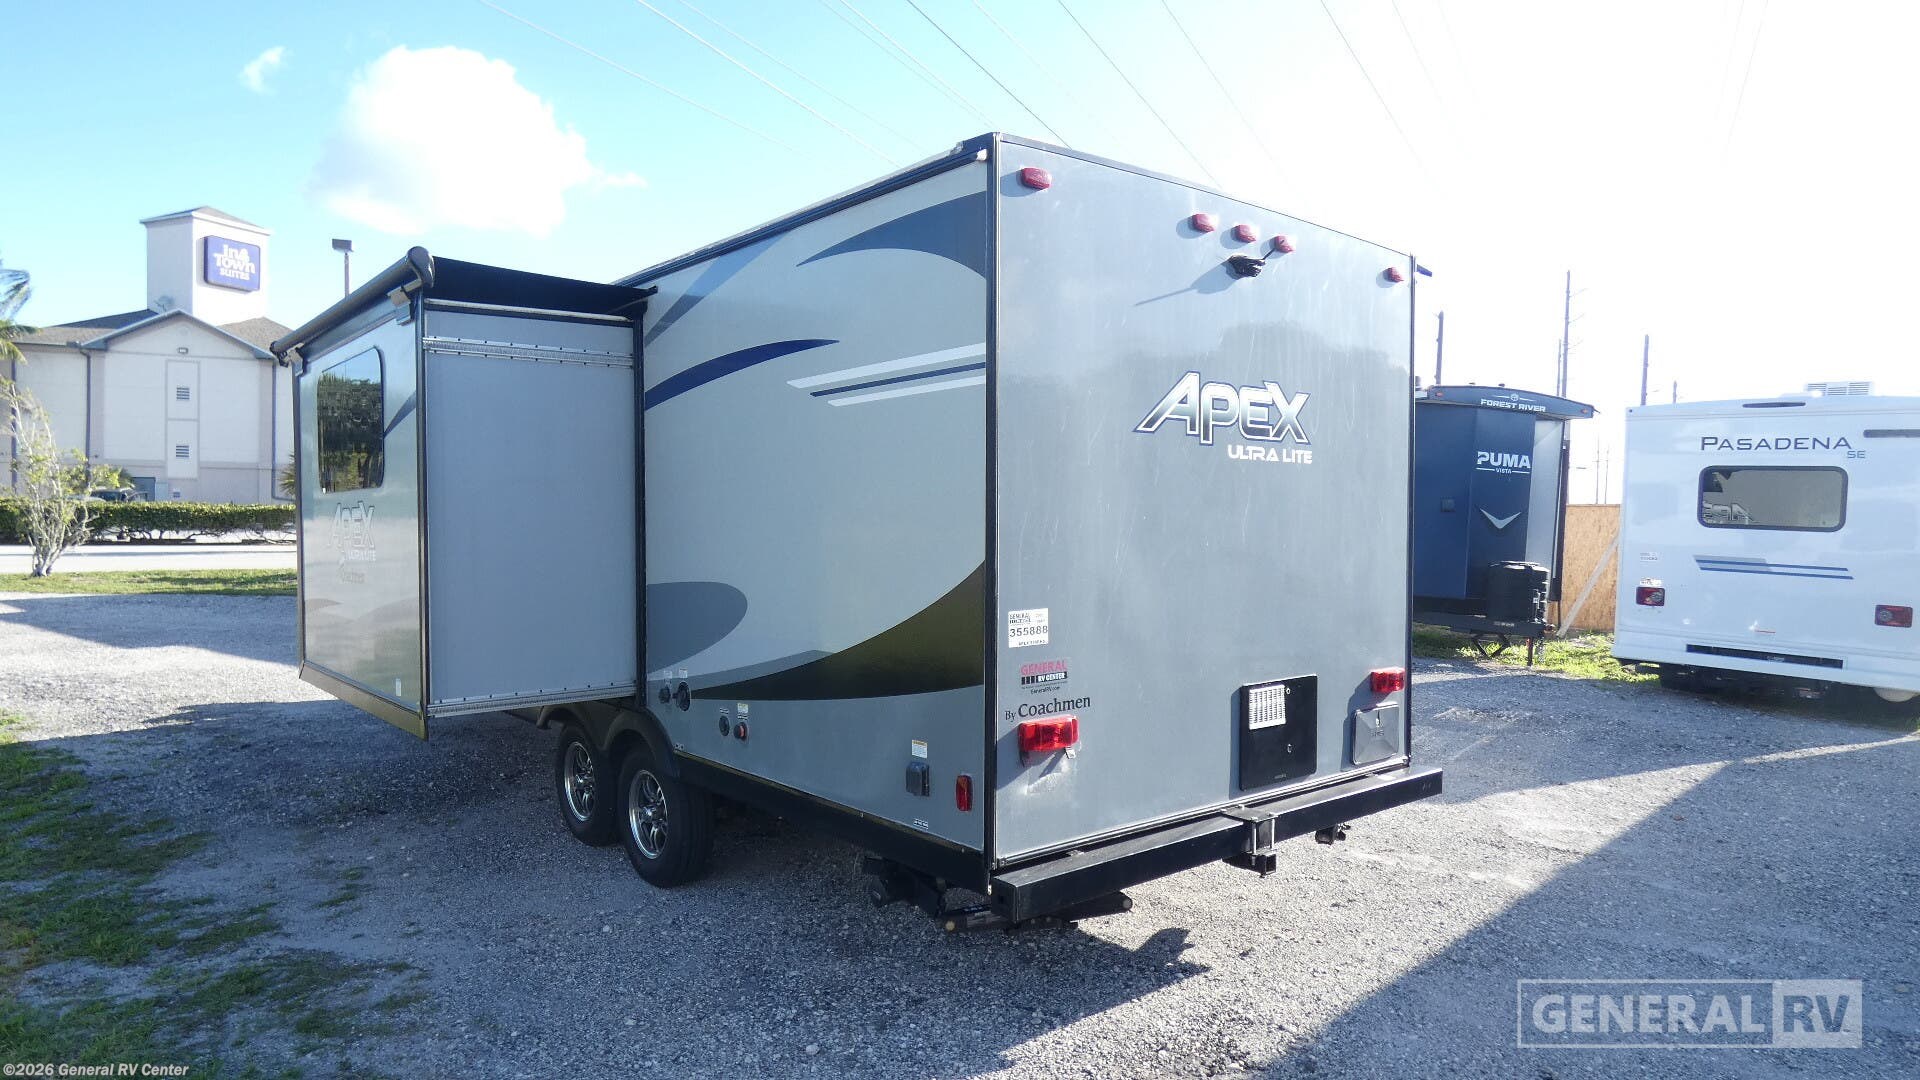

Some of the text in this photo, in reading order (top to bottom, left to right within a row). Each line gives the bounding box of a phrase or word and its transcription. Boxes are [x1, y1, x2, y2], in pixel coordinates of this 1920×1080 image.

[1132, 371, 1311, 446] APEX
[1480, 398, 1547, 412] FOREST RIVER
[1700, 436, 1852, 451] PASADENA
[1227, 444, 1313, 465] ULTRA LITE
[1476, 451, 1532, 468] PUMA
[1846, 450, 1866, 459] SE
[1009, 625, 1048, 638] 355888
[1020, 660, 1068, 676] GENERAL
[1005, 696, 1091, 722] By Coachmen
